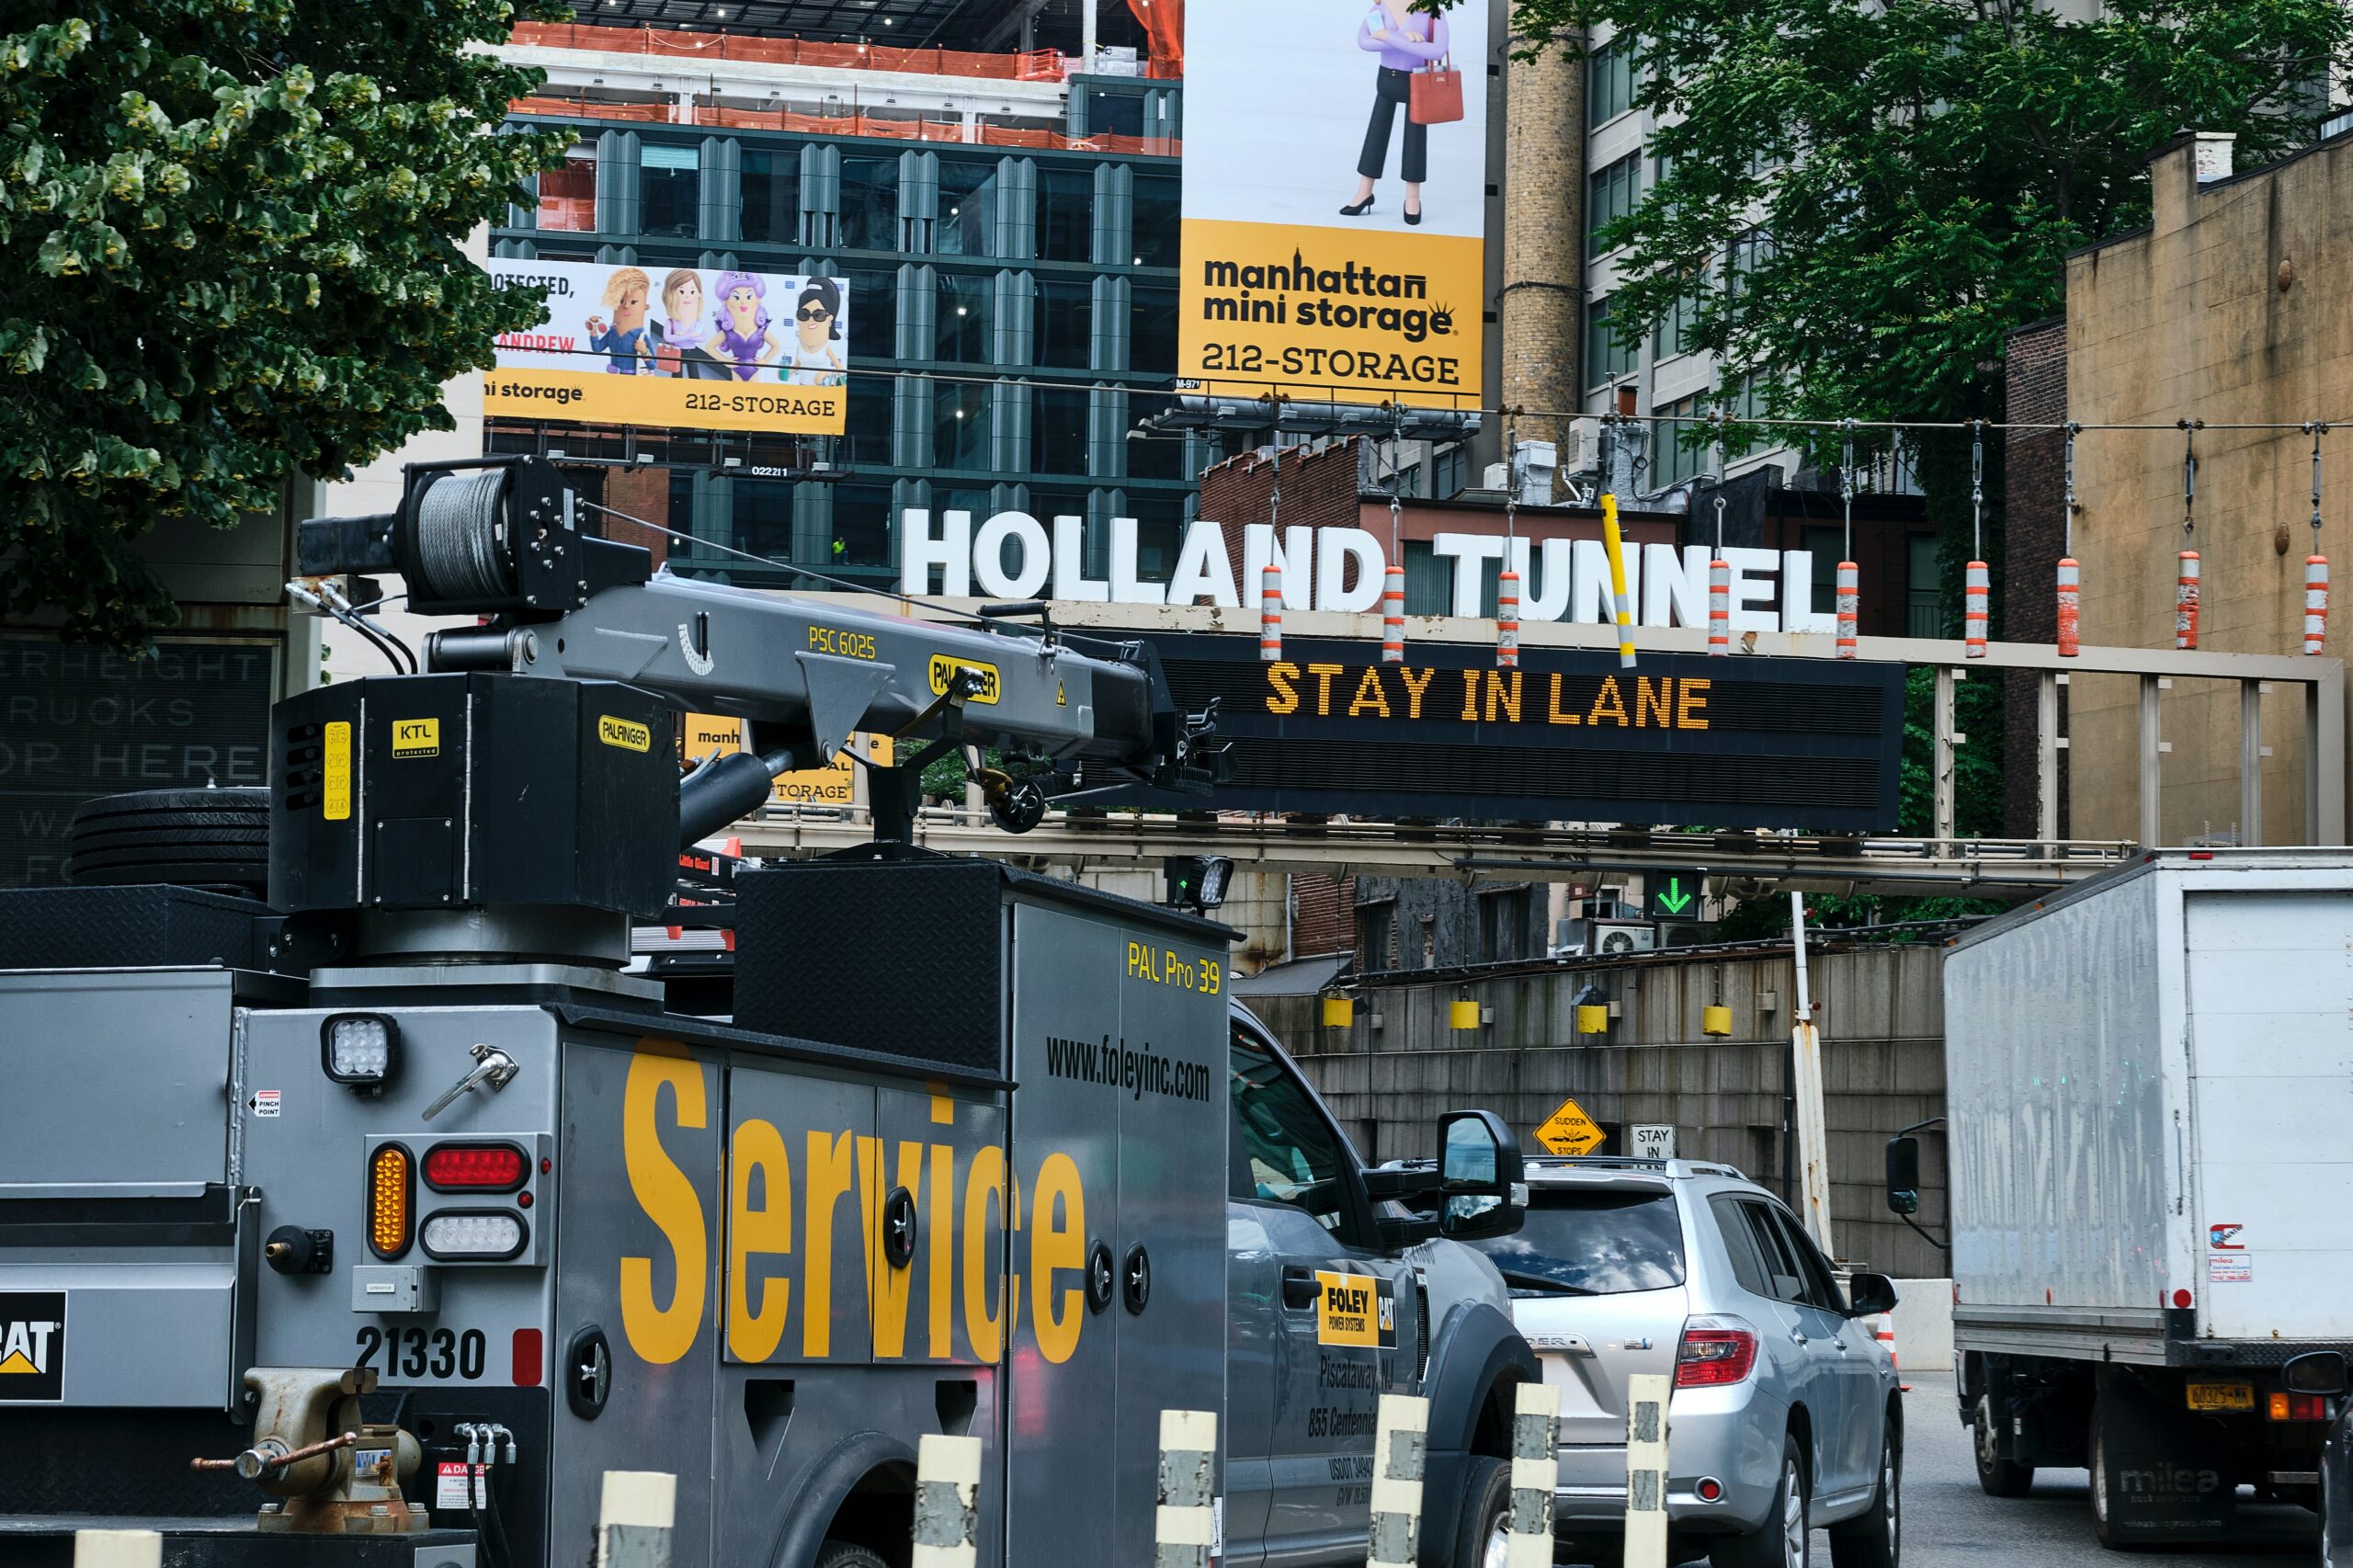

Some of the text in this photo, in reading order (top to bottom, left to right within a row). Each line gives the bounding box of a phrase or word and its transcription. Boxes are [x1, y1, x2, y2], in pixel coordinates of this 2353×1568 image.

[1204, 244, 1427, 299] manhattan
[1203, 290, 1456, 343] mini storage
[497, 334, 575, 355] ANDREW
[1202, 343, 1460, 385] 212-STORAGE
[502, 383, 585, 404] storage
[686, 393, 835, 417] 212-STORAGE
[900, 508, 1837, 633] HOLLAND TUNNEL
[809, 626, 876, 660] PSC 6025
[934, 661, 996, 698] PALER
[1266, 661, 1711, 731] STAY IN LANE
[401, 724, 432, 740] KTL
[602, 722, 647, 747] PALFINGER
[396, 748, 436, 757] protected
[773, 783, 847, 798] TORAGE
[1128, 942, 1221, 995] PAL Pro 39
[1047, 1034, 1210, 1103] www.foleyinc.com
[1554, 1117, 1586, 1126] SUDDEN
[1638, 1130, 1669, 1142] STAY
[1647, 1147, 1659, 1158] IN
[620, 1037, 1086, 1364] Service
[1328, 1288, 1393, 1331] FOLEY CAT
[1329, 1316, 1365, 1332] POWER SYSTEMS
[0, 1321, 54, 1373] AT
[354, 1326, 486, 1380] 21330
[1320, 1355, 1393, 1396] Piscataway, NJ
[1309, 1406, 1377, 1437] 855 Centennia
[1328, 1457, 1352, 1480] USDOT
